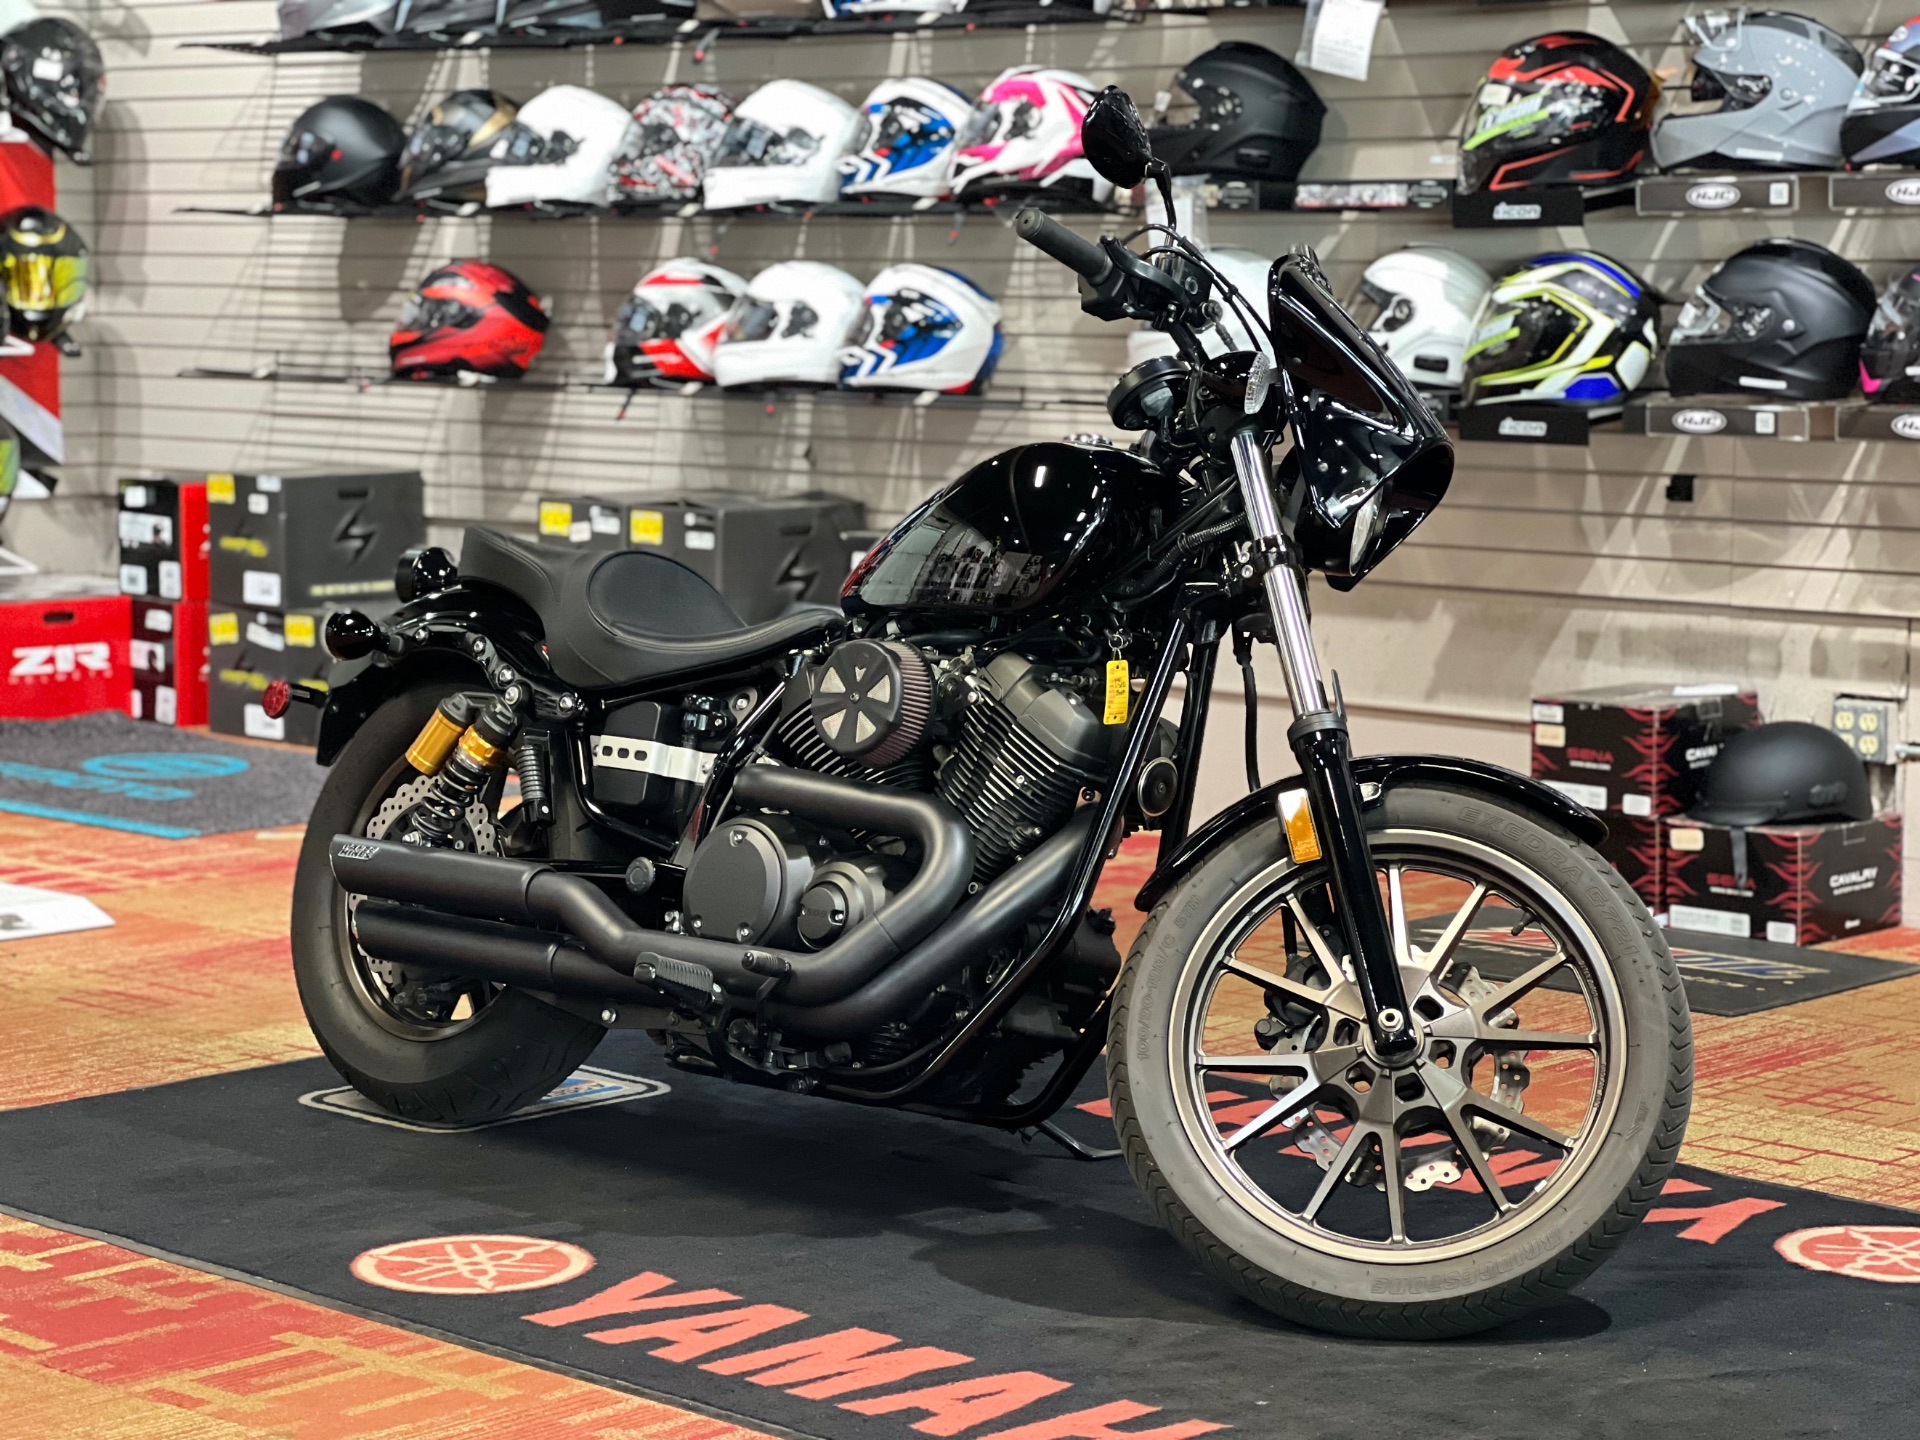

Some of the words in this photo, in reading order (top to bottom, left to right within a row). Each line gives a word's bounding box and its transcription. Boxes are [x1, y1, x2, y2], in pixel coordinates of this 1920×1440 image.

[1457, 805, 1585, 886] EXEDRA
[1706, 872, 1757, 890] SEA
[1829, 866, 1878, 888] CAVALRY
[1583, 885, 1641, 955] G721
